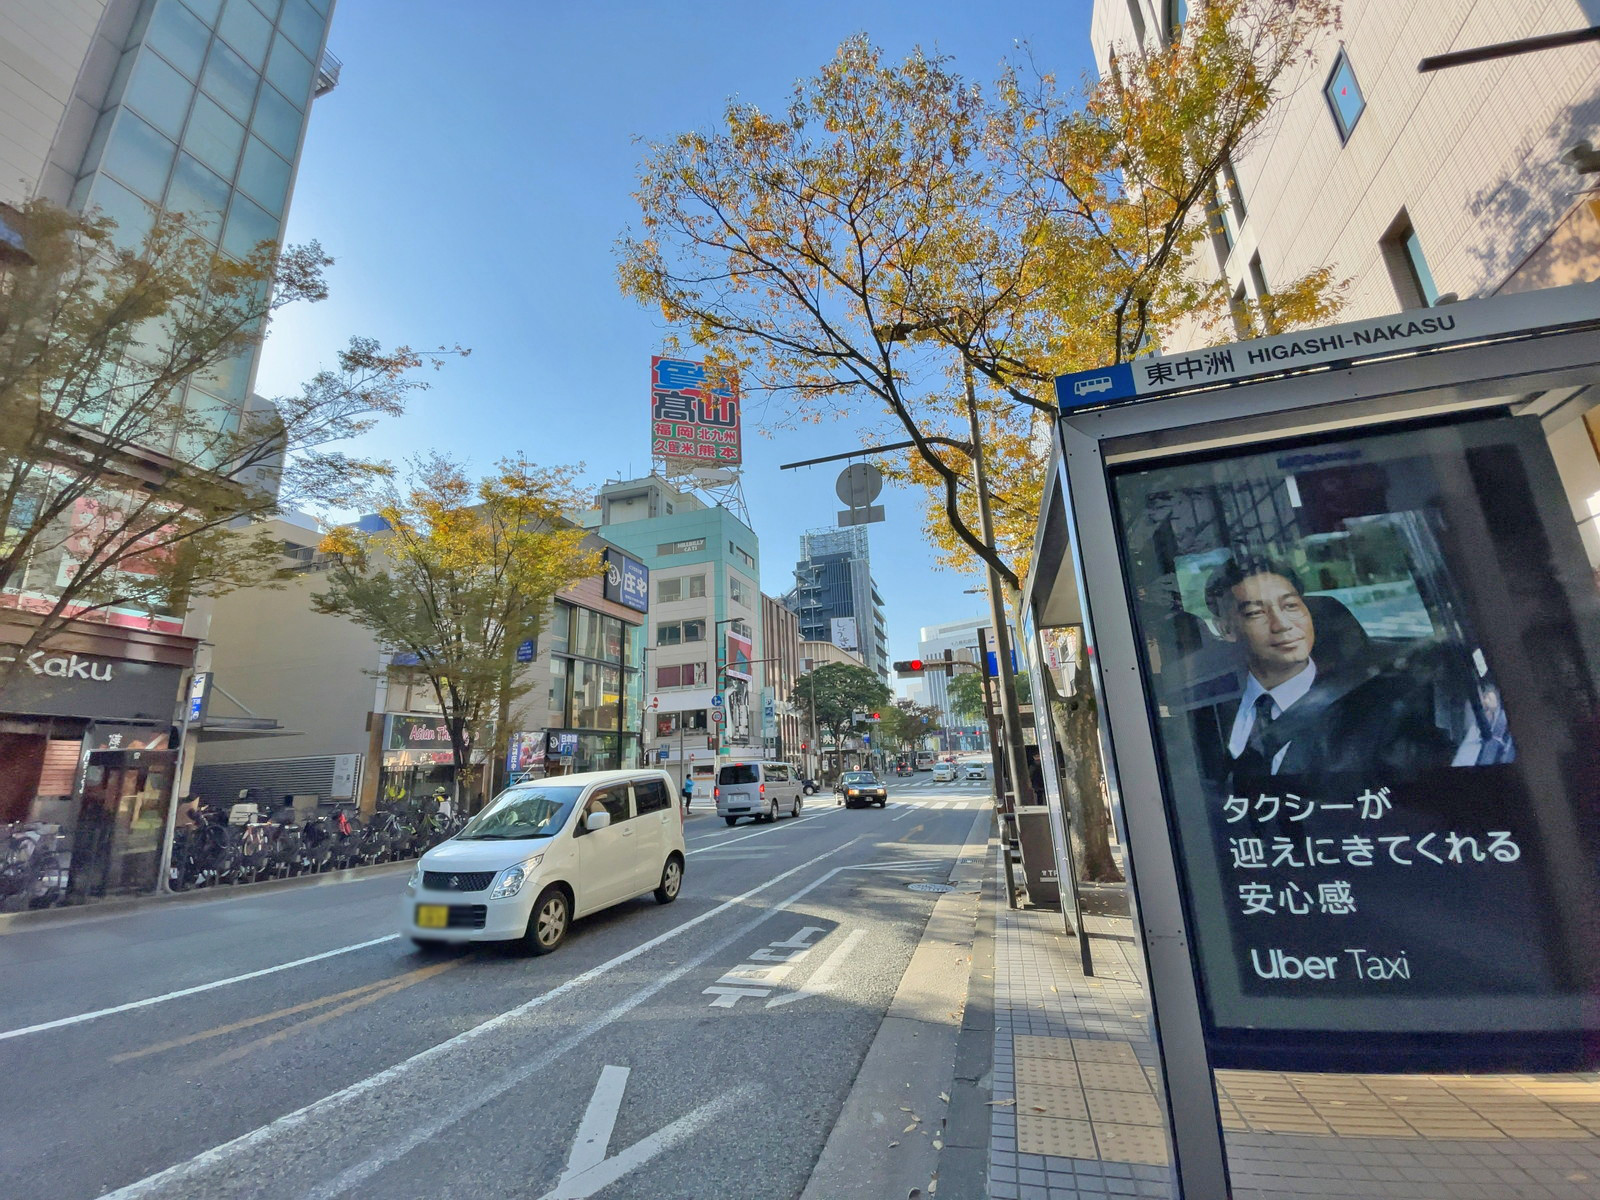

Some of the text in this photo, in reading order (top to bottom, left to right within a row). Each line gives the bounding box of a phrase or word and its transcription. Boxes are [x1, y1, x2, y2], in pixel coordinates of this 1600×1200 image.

[1144, 314, 1456, 387] 東中洲 HIGASHI-NAKASU
[697, 427, 736, 444] 北九州
[624, 572, 647, 598] 庄や
[409, 724, 435, 741] Asian
[1222, 786, 1393, 824] タクシーが
[1229, 830, 1521, 869] 迎えにきてくれる
[1238, 880, 1357, 916] 安心感
[1250, 948, 1411, 980] Uber Taxi
